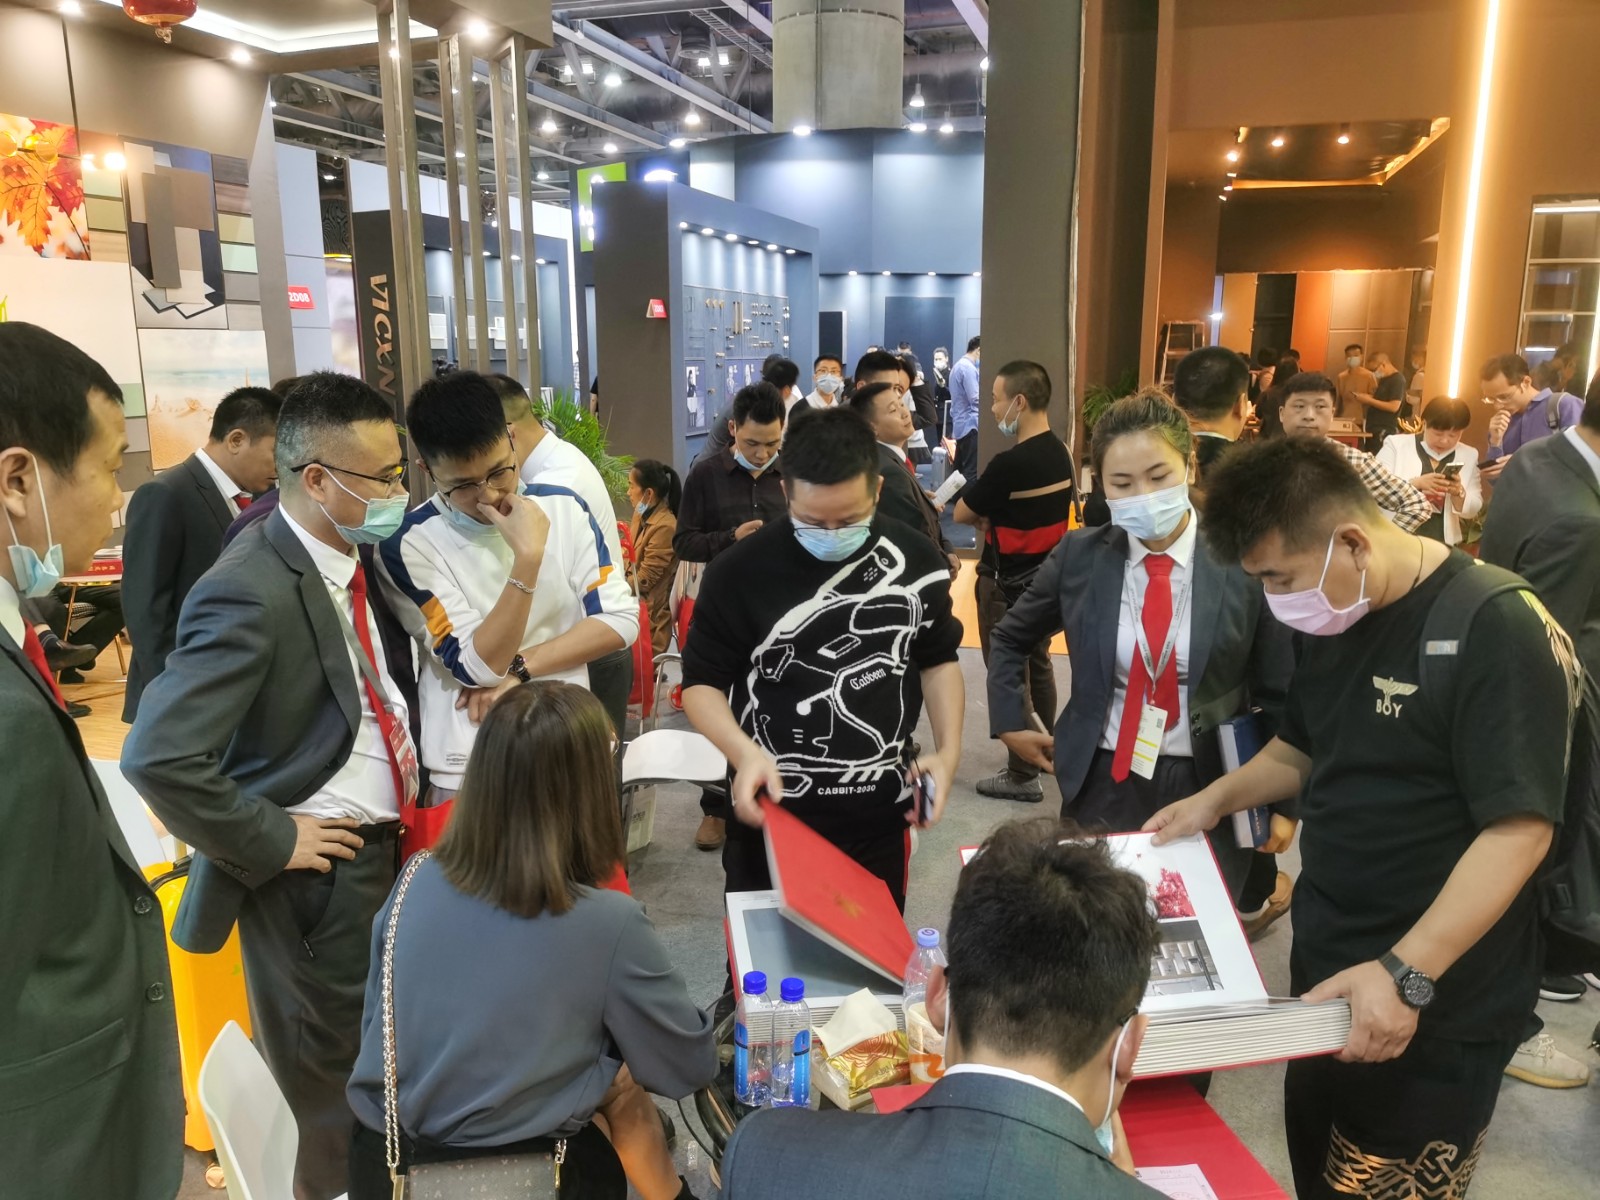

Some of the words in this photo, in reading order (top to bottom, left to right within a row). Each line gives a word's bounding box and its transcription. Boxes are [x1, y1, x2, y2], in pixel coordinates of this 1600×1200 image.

[850, 668, 886, 690] Cabbeen
[1375, 698, 1403, 718] BOY
[817, 784, 876, 796] CABBIT-2030
